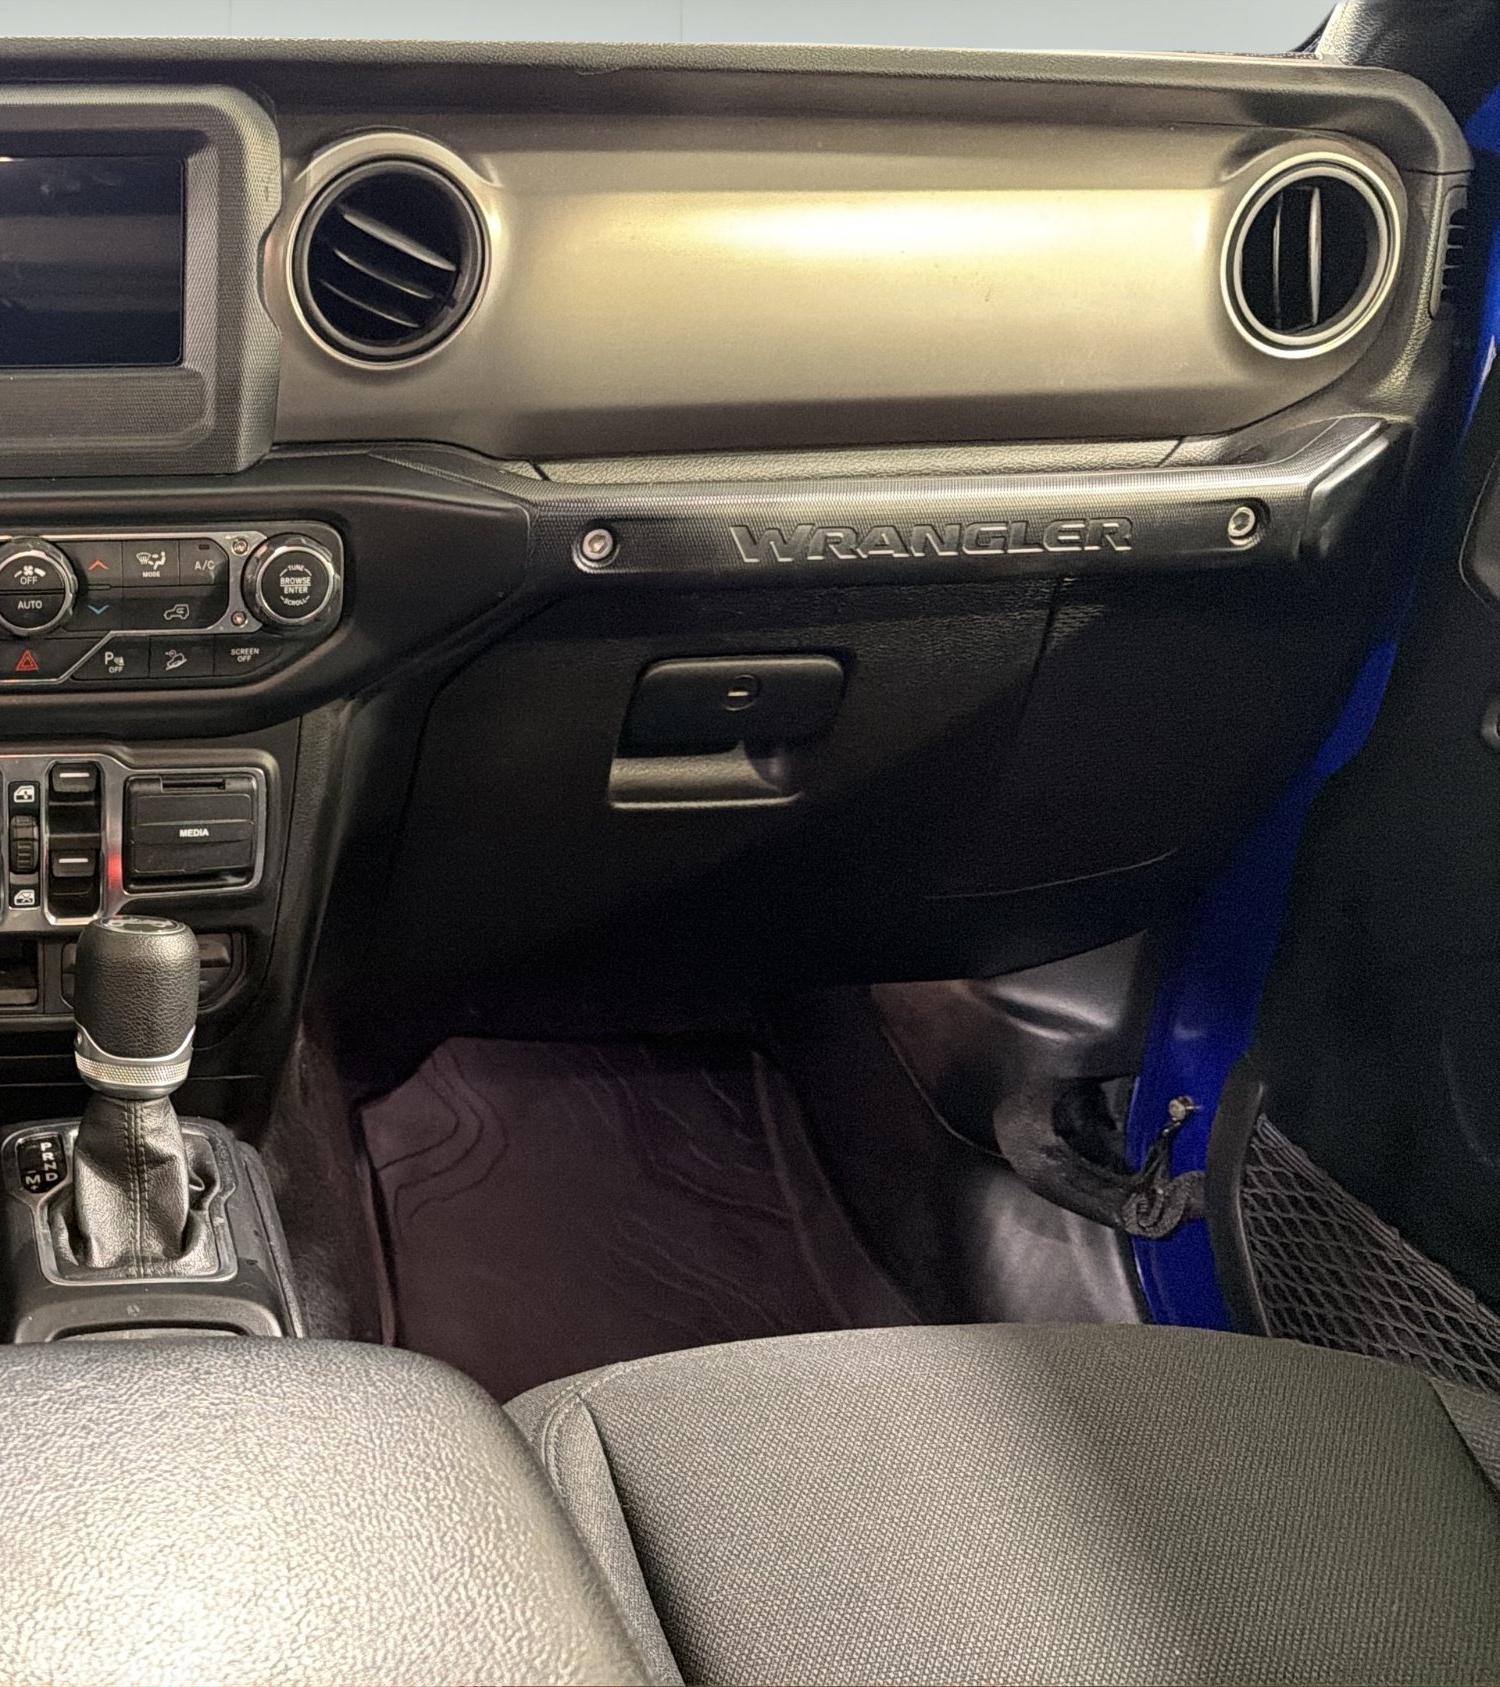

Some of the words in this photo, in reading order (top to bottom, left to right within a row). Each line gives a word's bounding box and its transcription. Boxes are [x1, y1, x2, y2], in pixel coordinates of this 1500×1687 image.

[728, 517, 1133, 563] WRANGLER
[194, 560, 215, 571] A/C
[287, 564, 305, 572] TUNE
[20, 576, 38, 585] OFF
[280, 576, 311, 585] BROWSE
[283, 586, 308, 594] ENTER
[17, 600, 43, 610] AUTO
[283, 597, 308, 606] SCROLL
[231, 648, 259, 656] SCREEN
[179, 828, 209, 837] MEDIA
[40, 1142, 52, 1151] P
[42, 1152, 55, 1161] R
[44, 1161, 57, 1171] N
[25, 1174, 41, 1185] M
[45, 1172, 58, 1181] D
